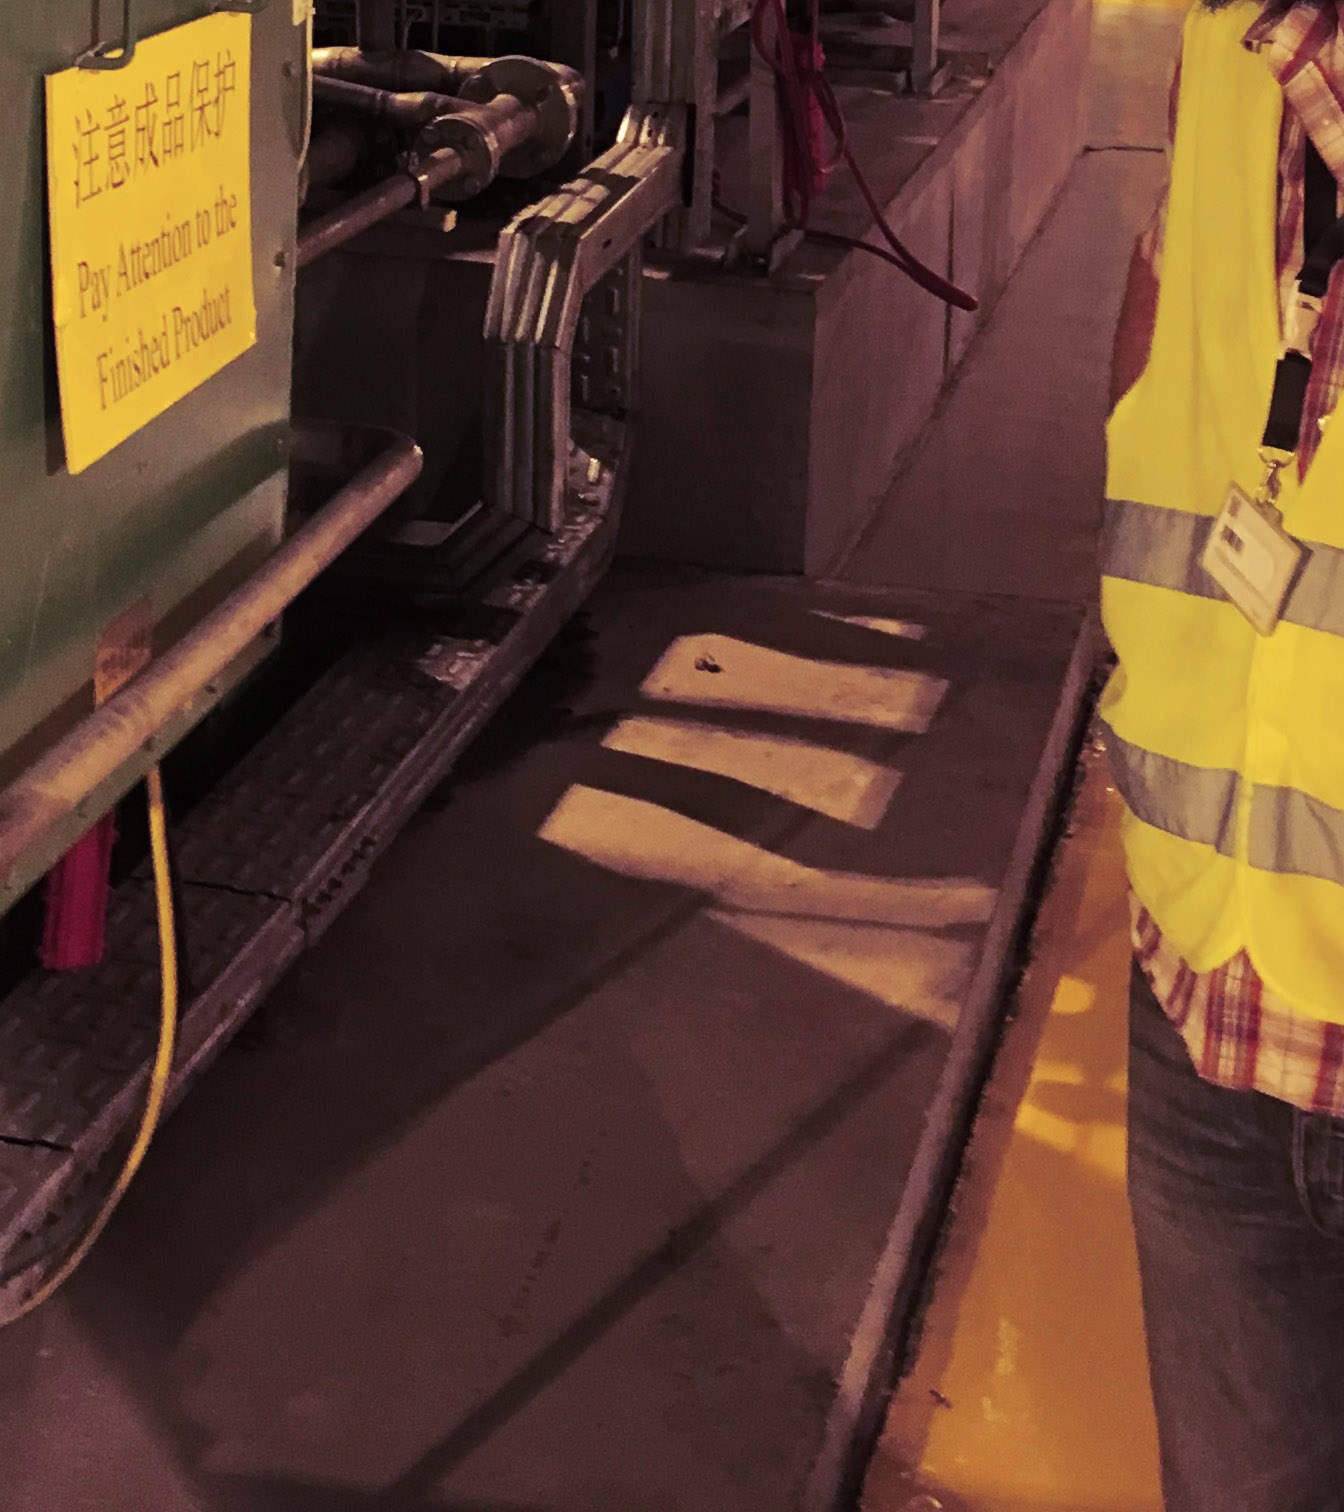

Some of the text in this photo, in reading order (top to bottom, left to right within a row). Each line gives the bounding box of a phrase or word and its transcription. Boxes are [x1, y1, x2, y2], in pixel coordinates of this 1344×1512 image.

[72, 49, 236, 208] 注意成品保护
[77, 185, 237, 322] Pay Attention to the
[97, 284, 232, 410] Finished Product
